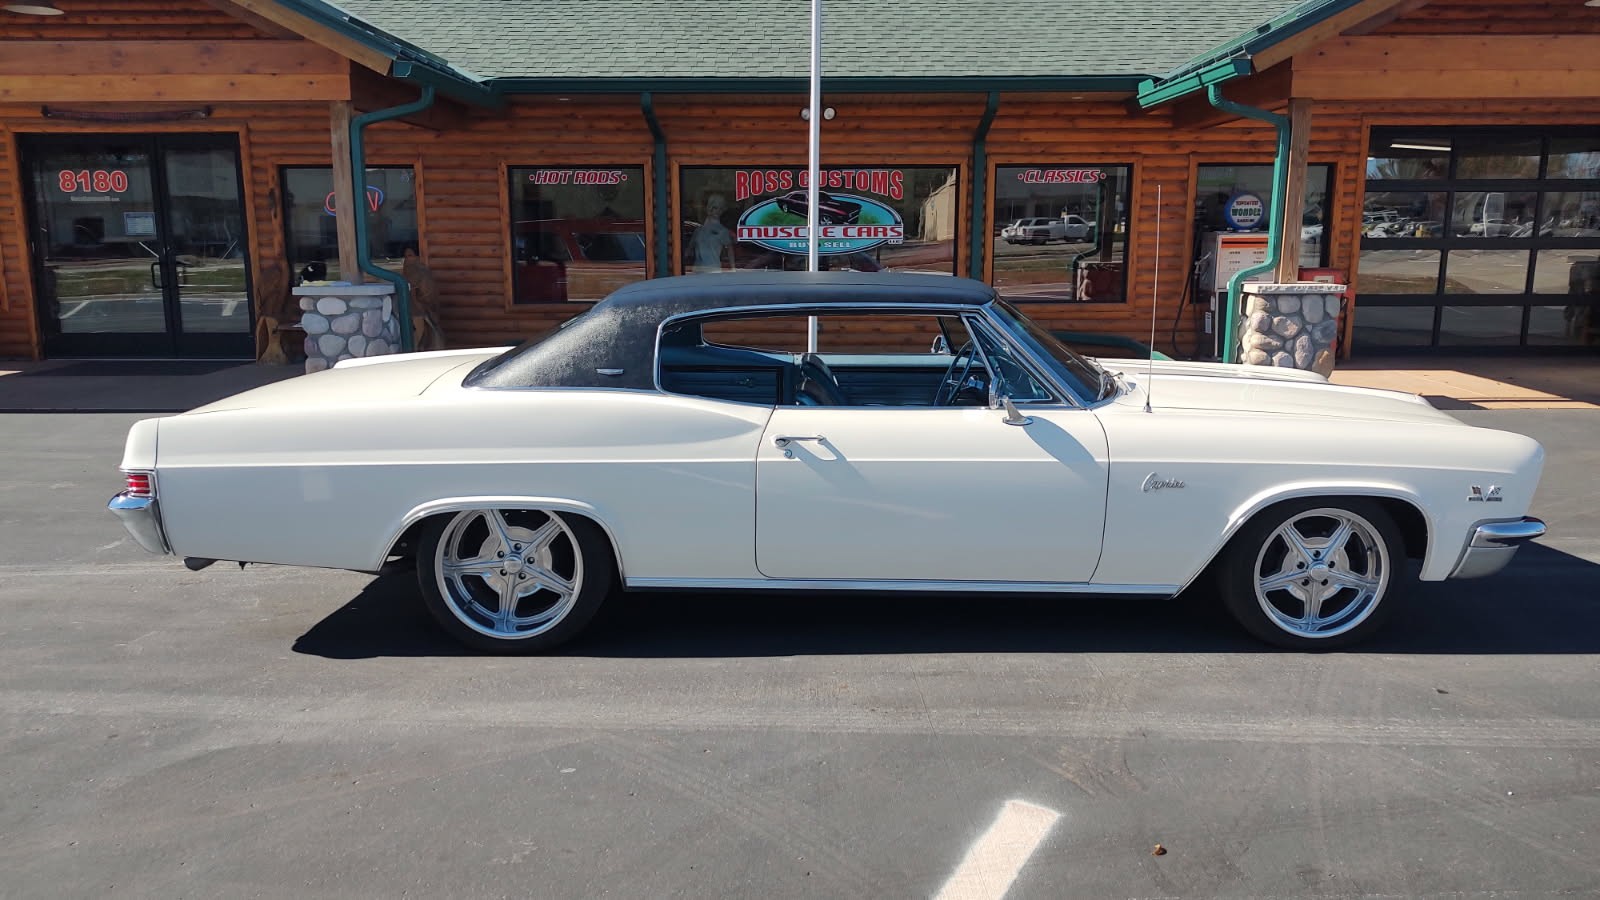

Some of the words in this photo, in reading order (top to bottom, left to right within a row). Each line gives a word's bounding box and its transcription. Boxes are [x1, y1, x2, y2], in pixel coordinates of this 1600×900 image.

[59, 170, 128, 192] 8180
[535, 171, 572, 184] HOT
[573, 171, 622, 184] RODS
[1024, 170, 1101, 183] CLASSICS
[736, 170, 793, 201] ROSS
[798, 170, 904, 200] CUSTOMS
[842, 226, 903, 238] CARS
